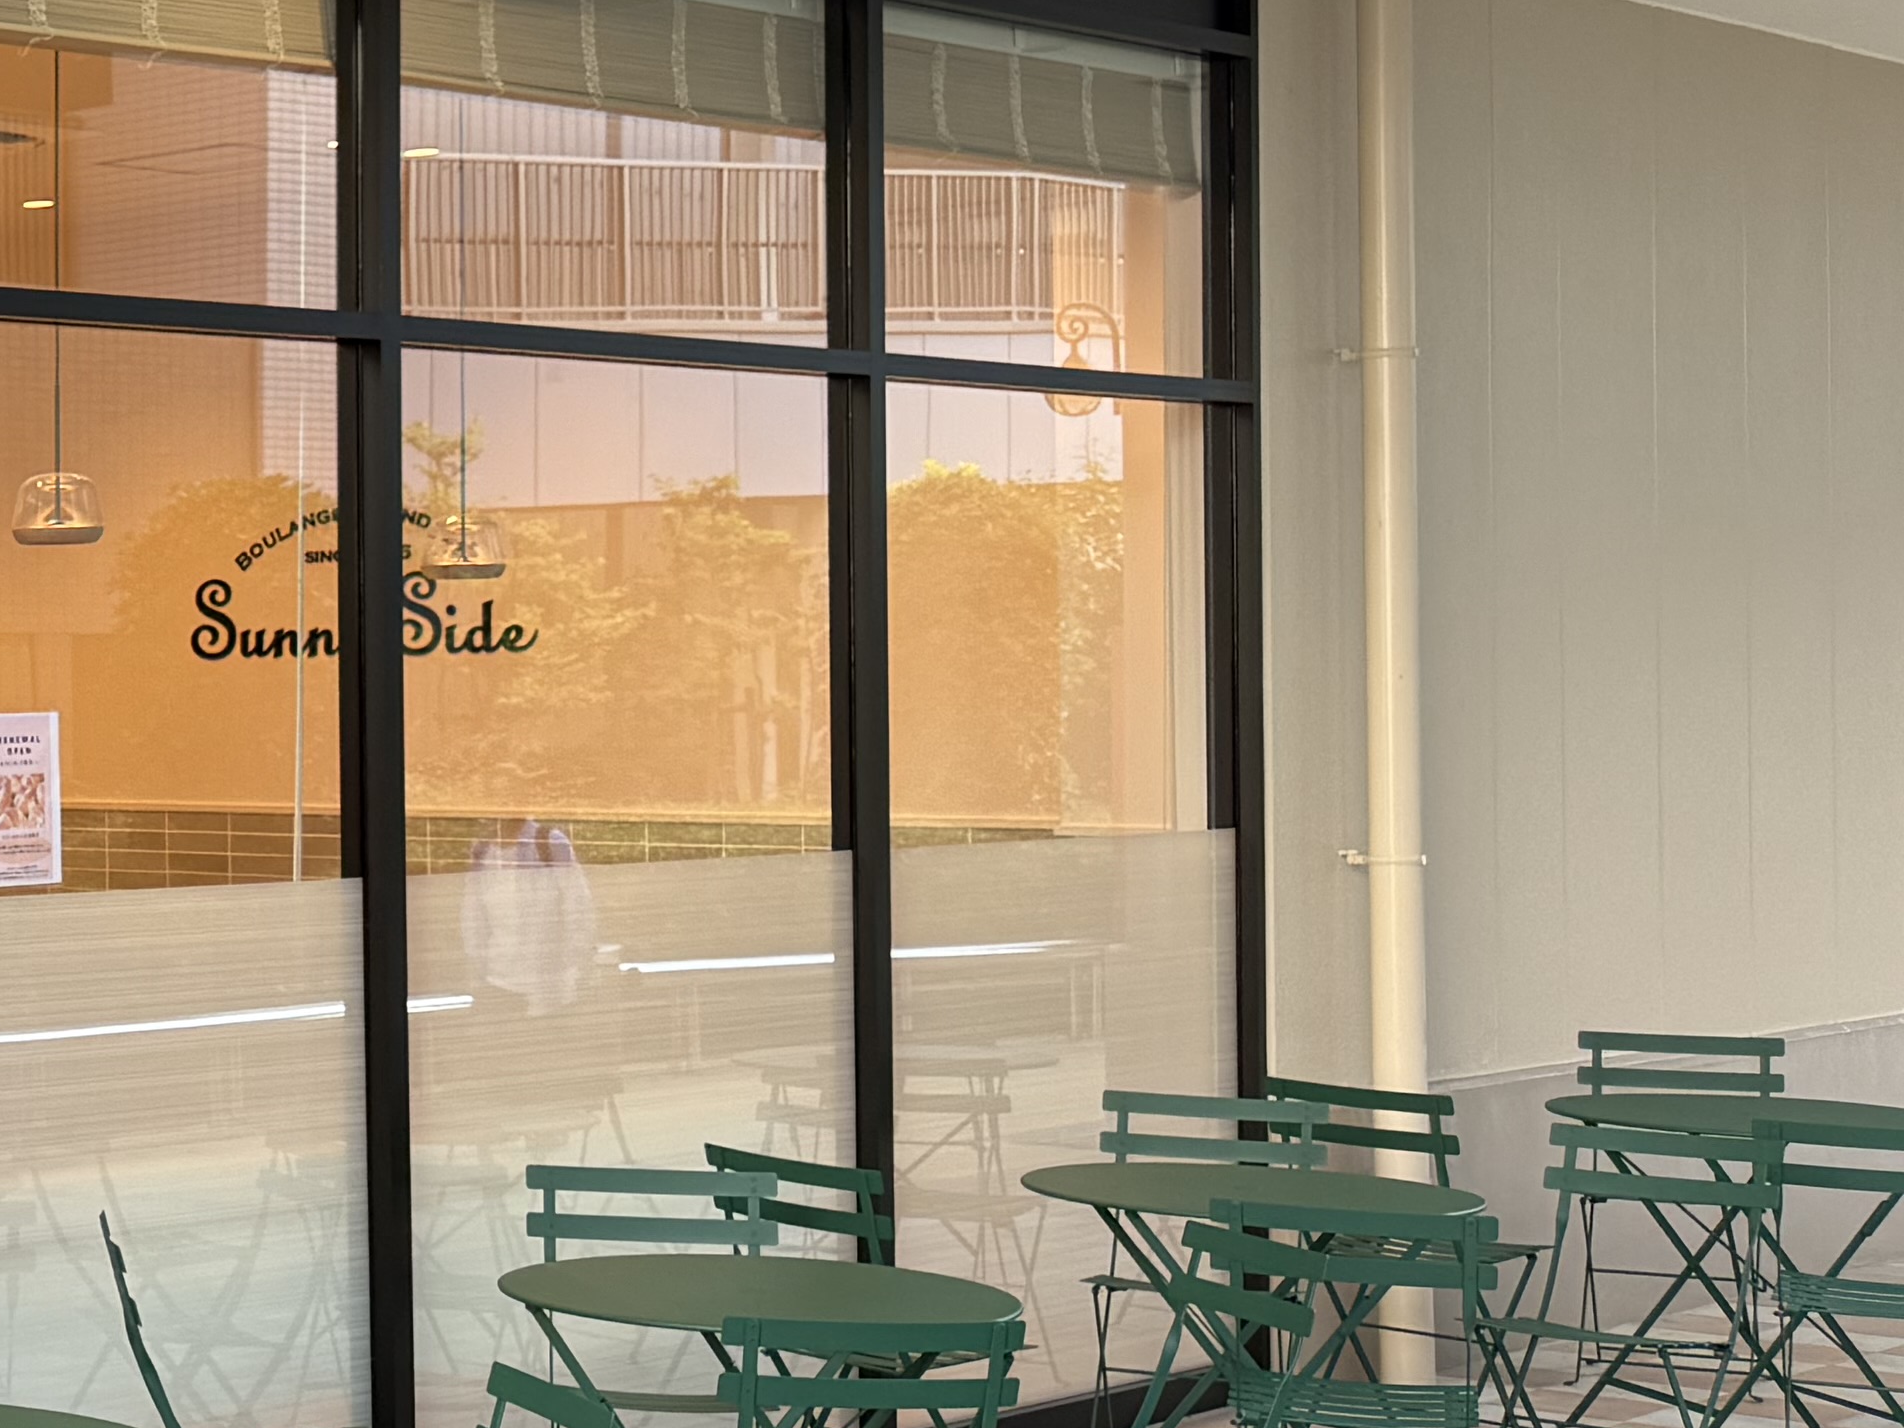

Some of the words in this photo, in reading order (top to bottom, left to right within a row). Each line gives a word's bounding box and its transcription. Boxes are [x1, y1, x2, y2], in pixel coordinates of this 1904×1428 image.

[234, 507, 339, 571] BOULANG
[190, 579, 340, 660] Sunn
[402, 571, 539, 656] Side
